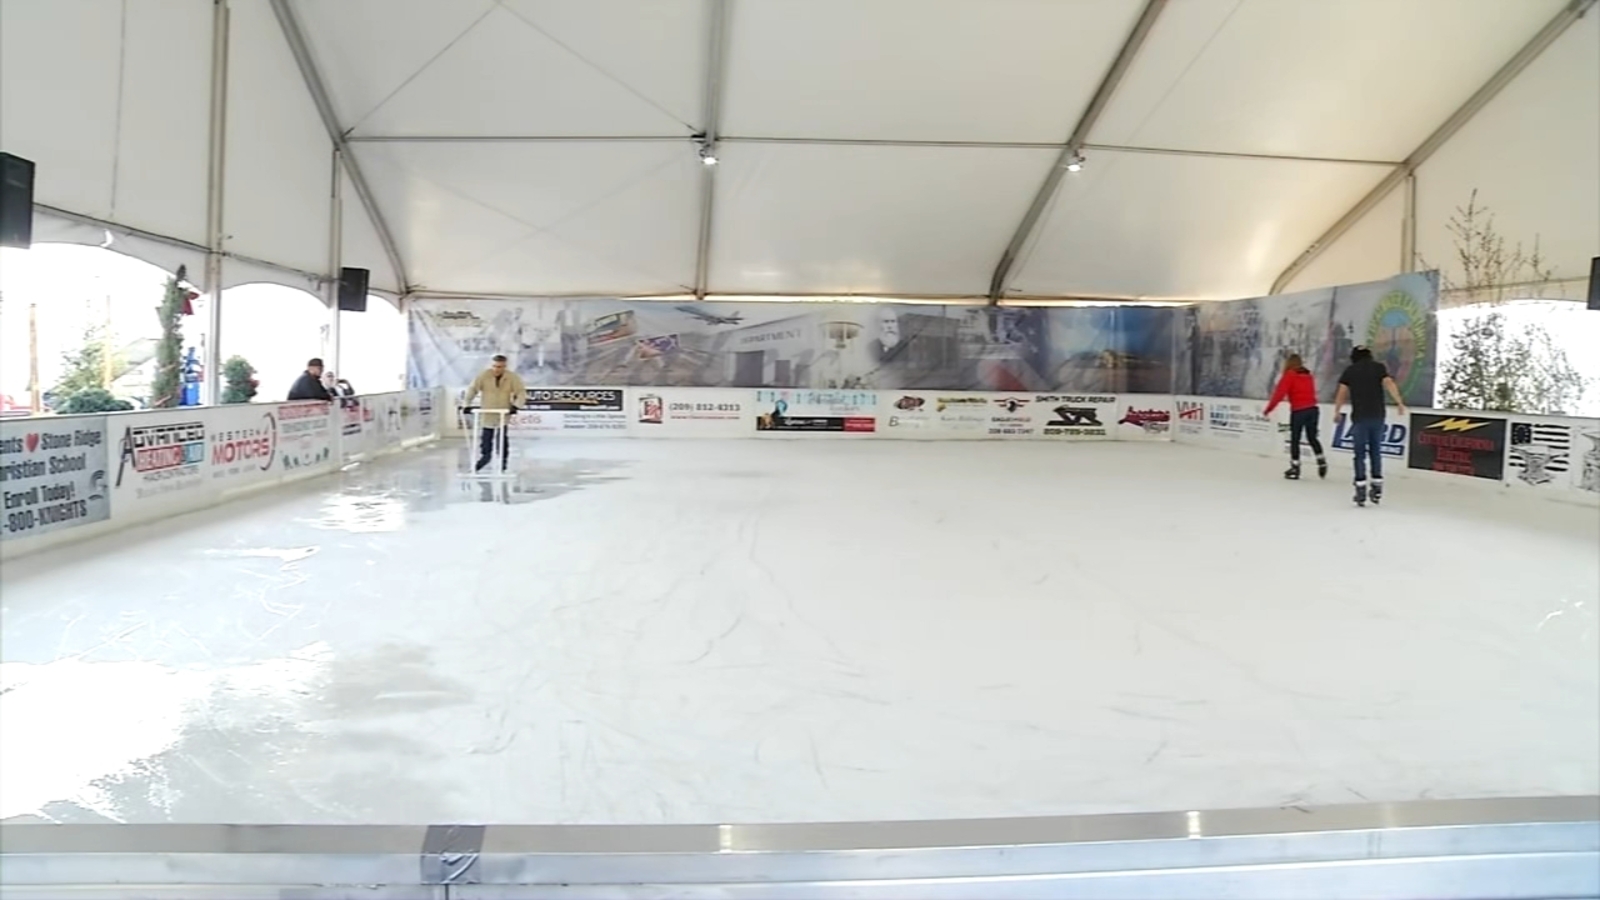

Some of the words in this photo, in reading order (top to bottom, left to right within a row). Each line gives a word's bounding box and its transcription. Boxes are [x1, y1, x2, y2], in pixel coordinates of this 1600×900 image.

[554, 391, 616, 401] RESOURCES
[41, 432, 71, 450] Stone
[74, 429, 102, 448] Ridge
[212, 438, 270, 466] MOTORS
[49, 453, 85, 475] School
[4, 487, 39, 510] Enroll
[41, 481, 75, 501] Today!
[0, 499, 88, 534] -800-KNIGHTS
